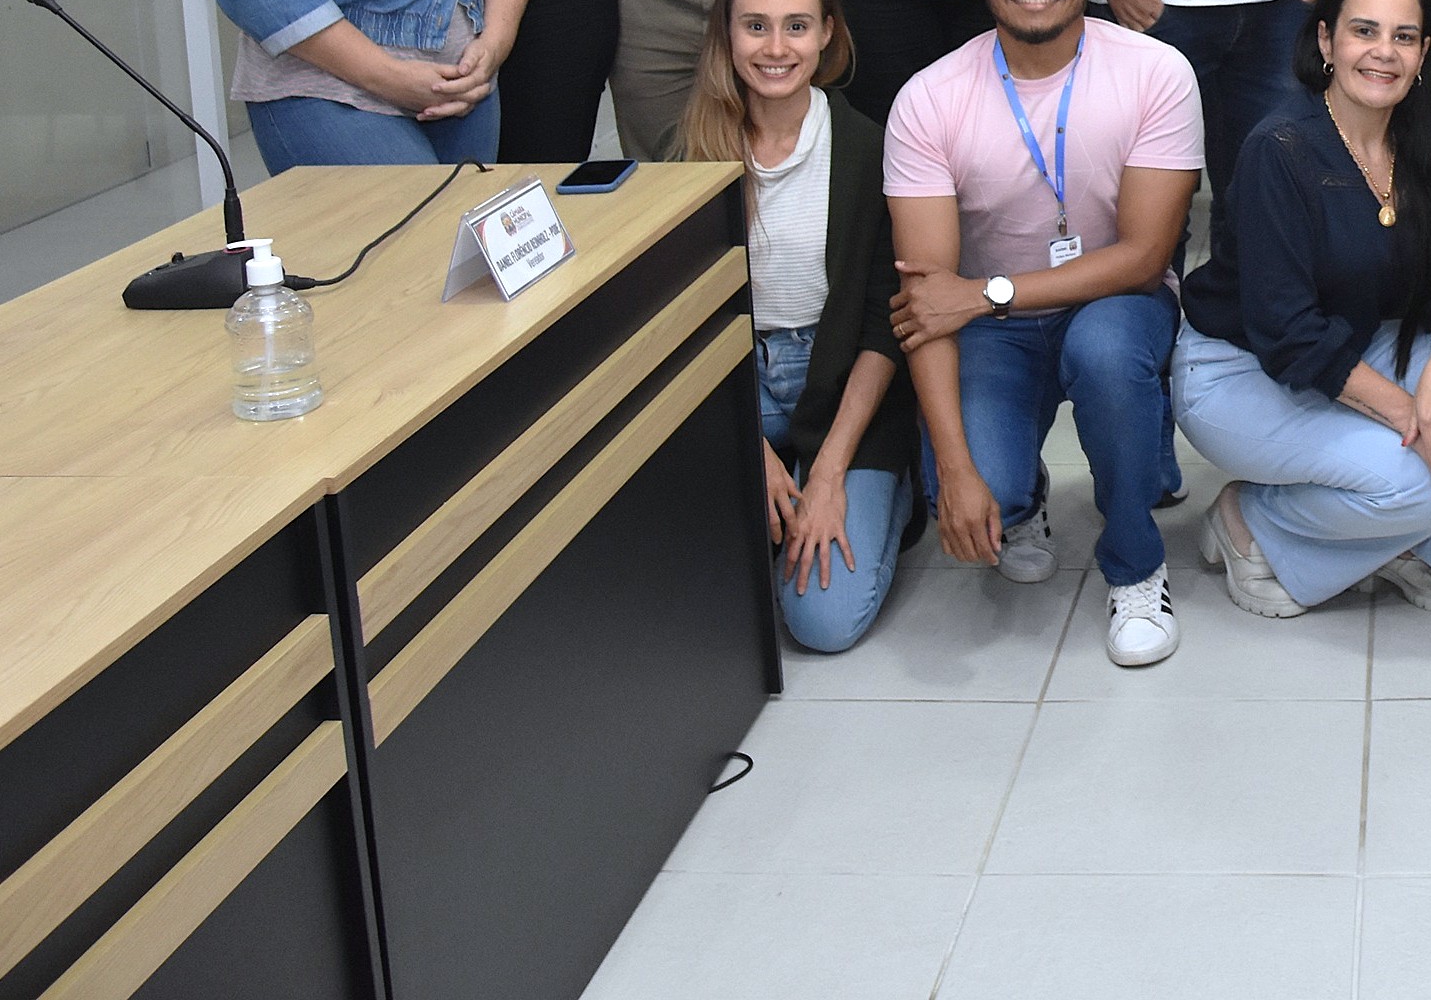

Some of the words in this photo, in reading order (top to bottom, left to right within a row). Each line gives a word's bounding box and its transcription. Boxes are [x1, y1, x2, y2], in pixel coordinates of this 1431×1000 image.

[496, 254, 514, 272] DANIEL
[510, 241, 533, 263] FLORÊNCIO
[526, 252, 545, 268] Vereador
